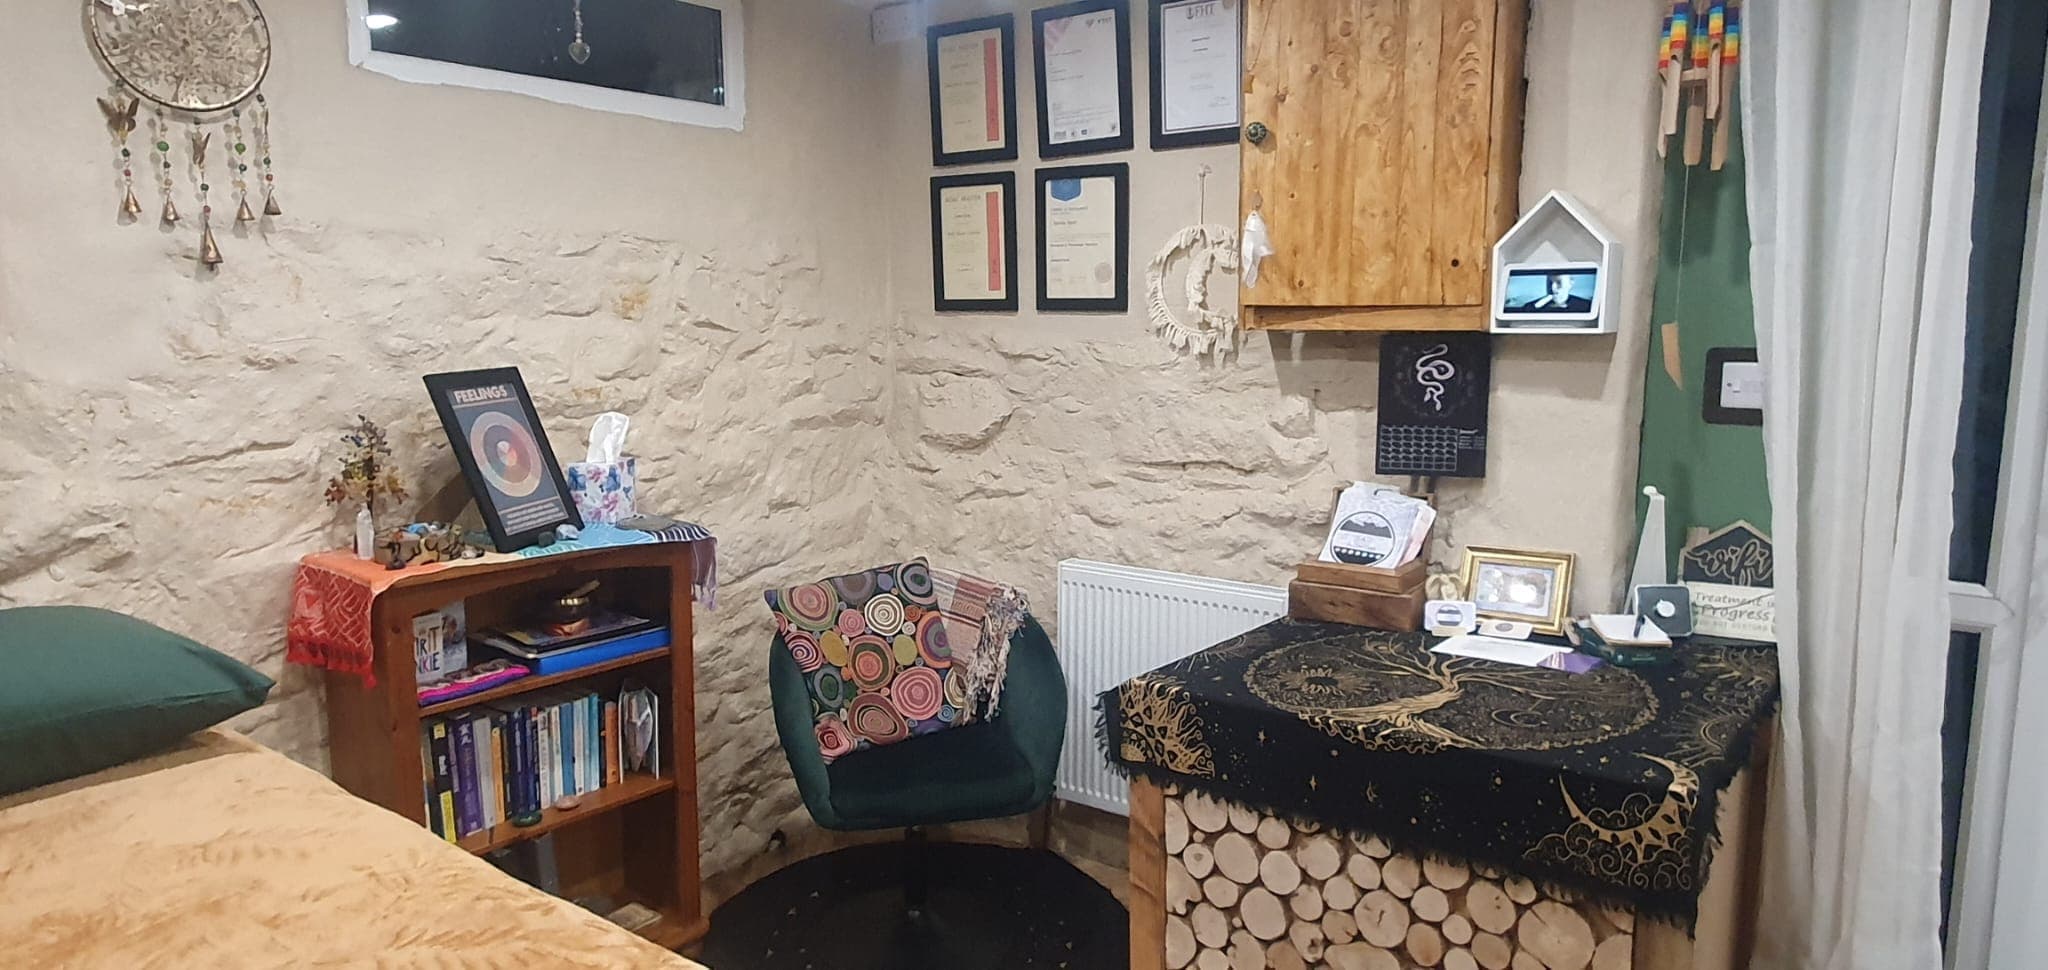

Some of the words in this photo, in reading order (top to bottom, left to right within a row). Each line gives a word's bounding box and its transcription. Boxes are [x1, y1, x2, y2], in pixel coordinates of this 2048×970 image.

[453, 384, 508, 404] FEELINGS
[1686, 538, 1774, 587] wifi
[1695, 592, 1763, 607] Treatment
[1701, 604, 1770, 622] Progress
